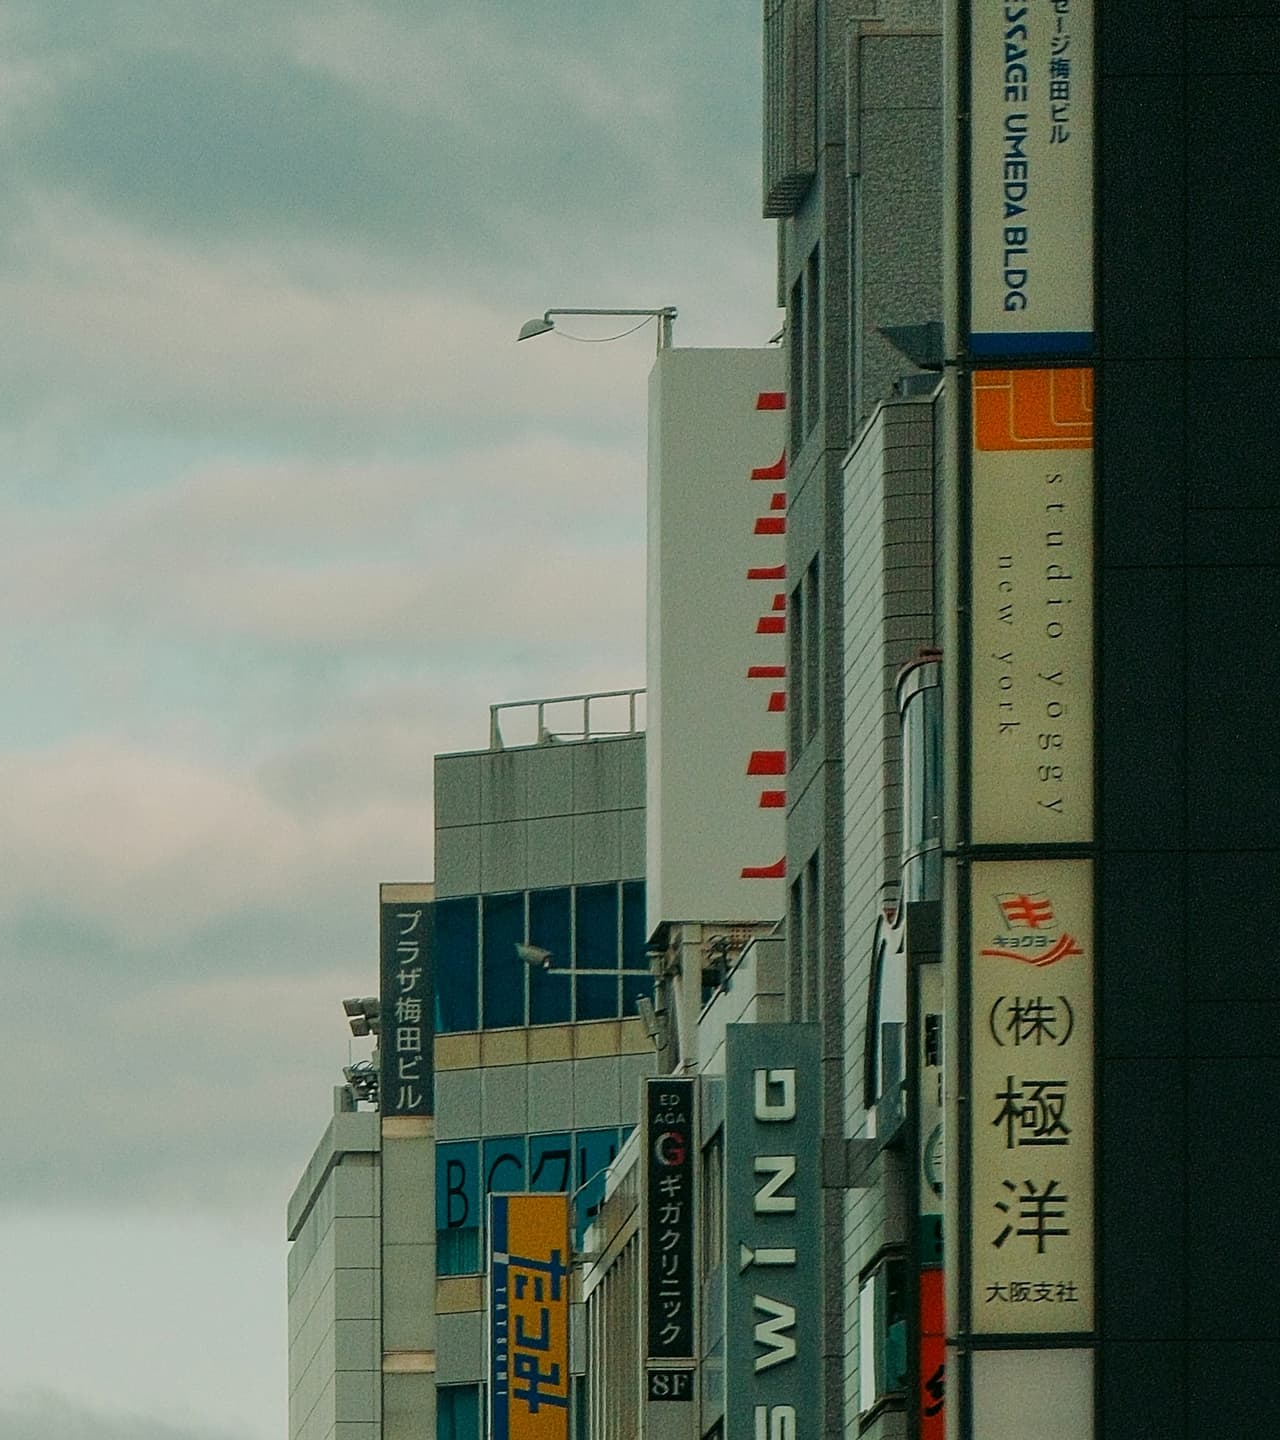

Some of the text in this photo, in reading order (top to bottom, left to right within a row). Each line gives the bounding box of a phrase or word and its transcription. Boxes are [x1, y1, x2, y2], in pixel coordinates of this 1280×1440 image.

[1004, 113, 1028, 312] UMEDA BLDG
[1045, 474, 1072, 639] studio
[993, 555, 1021, 735] new york
[395, 909, 423, 1110] プラザ梅田ビル
[993, 935, 1056, 949] キョクヨー
[659, 1173, 683, 1346] ギガクリニック
[986, 1281, 1079, 1304] 大阪支社
[652, 1373, 688, 1397] 8F
